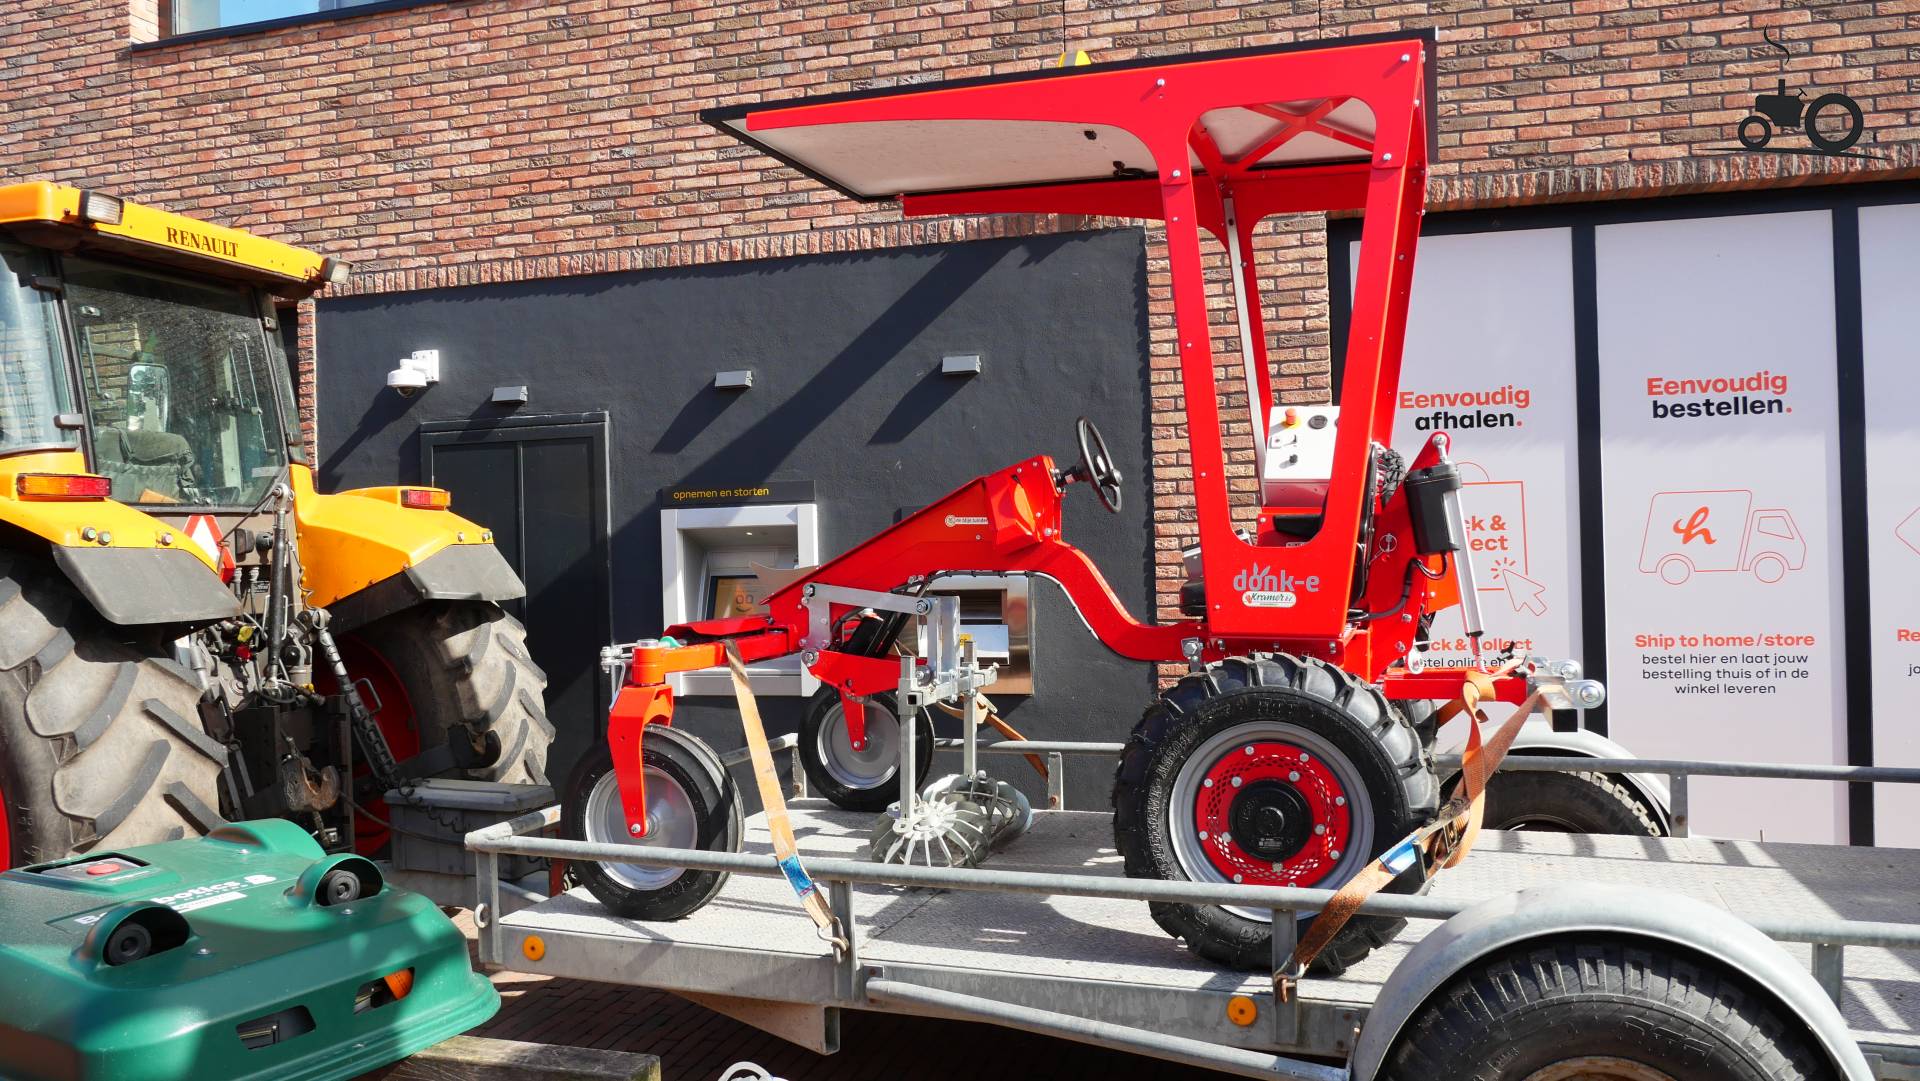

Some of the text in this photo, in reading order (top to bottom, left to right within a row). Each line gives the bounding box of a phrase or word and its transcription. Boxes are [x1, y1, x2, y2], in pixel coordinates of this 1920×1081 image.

[166, 226, 239, 257] RENAULT
[1647, 370, 1788, 395] Eenvoudig
[1399, 384, 1530, 409] Eenvoudig
[1652, 396, 1793, 418] bestellen.
[1414, 410, 1523, 430] afhalen.
[673, 489, 718, 500] opnemen
[734, 487, 770, 497] storten
[1634, 634, 1676, 650] Ship
[1678, 634, 1699, 647] to
[1642, 653, 1809, 666] bestel hier en laat jouw
[1642, 667, 1809, 681] bestelling thuis of in de
[1674, 683, 1777, 694] winkel leveren
